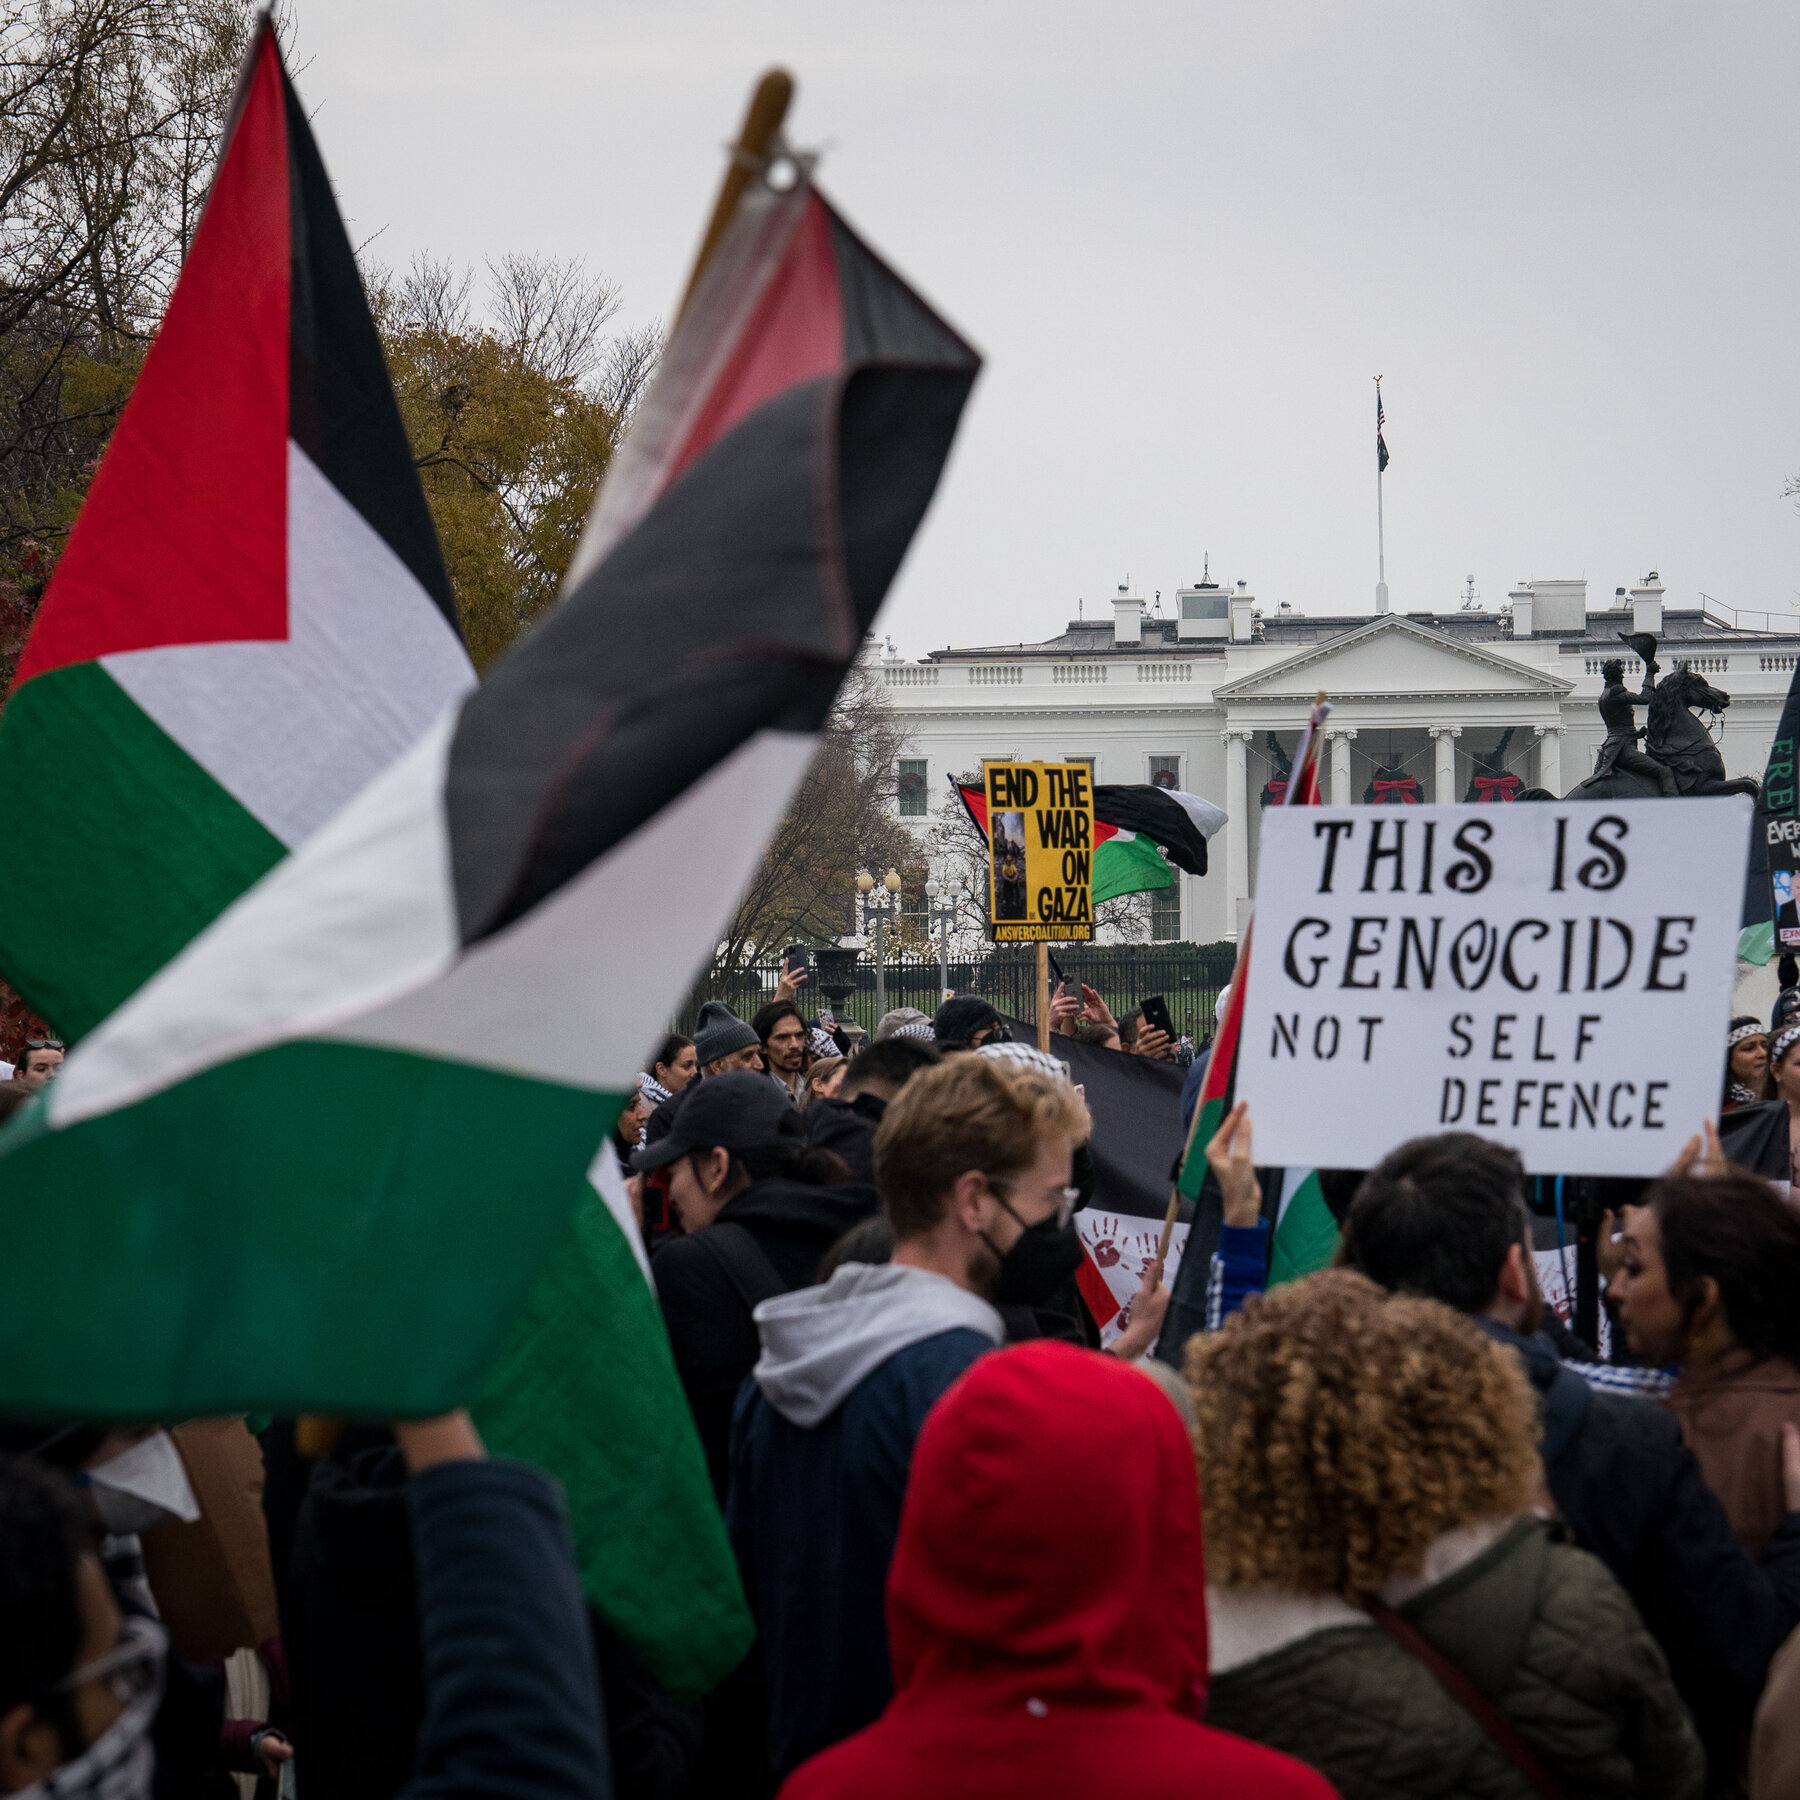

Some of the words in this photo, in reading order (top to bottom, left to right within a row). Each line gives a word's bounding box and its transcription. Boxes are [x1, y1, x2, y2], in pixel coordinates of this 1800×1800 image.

[988, 768, 1038, 807] END
[1044, 769, 1089, 807] THE
[1036, 810, 1089, 849] WAR
[1062, 850, 1089, 885] ON
[1314, 819, 1493, 894] THIS
[1550, 815, 1629, 891] IS
[1038, 887, 1089, 922] GAZA
[995, 925, 1090, 941] ANSWERCOALITION.ORG
[1284, 916, 1695, 993] GENOCIDE
[1271, 1013, 1383, 1063] NOT
[1447, 1013, 1602, 1062] SELF
[1440, 1077, 1669, 1130] DEFENCE
